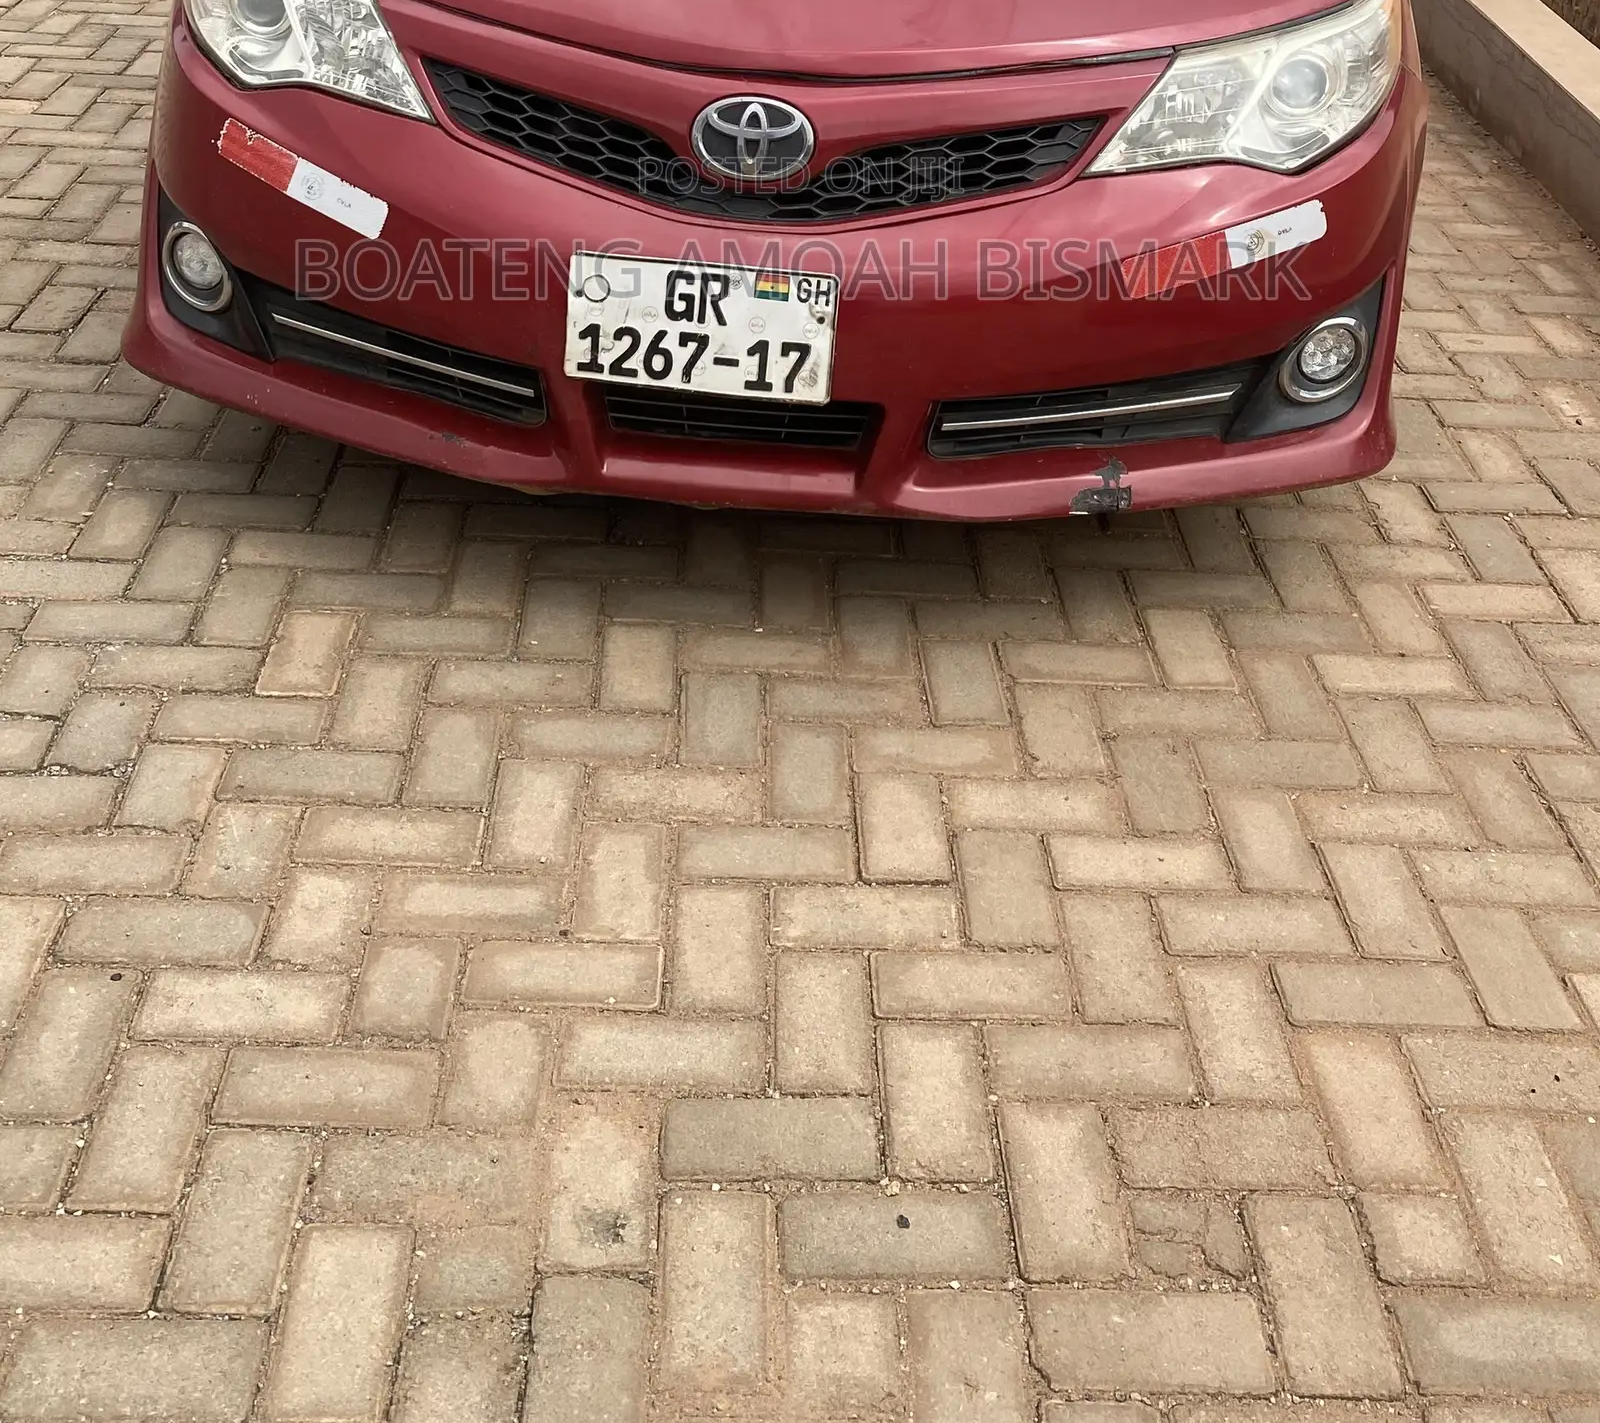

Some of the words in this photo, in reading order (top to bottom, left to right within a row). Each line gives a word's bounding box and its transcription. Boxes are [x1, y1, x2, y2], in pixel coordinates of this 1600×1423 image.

[664, 269, 731, 327] GR
[796, 277, 832, 307] GH
[576, 322, 813, 394] 1267-17
